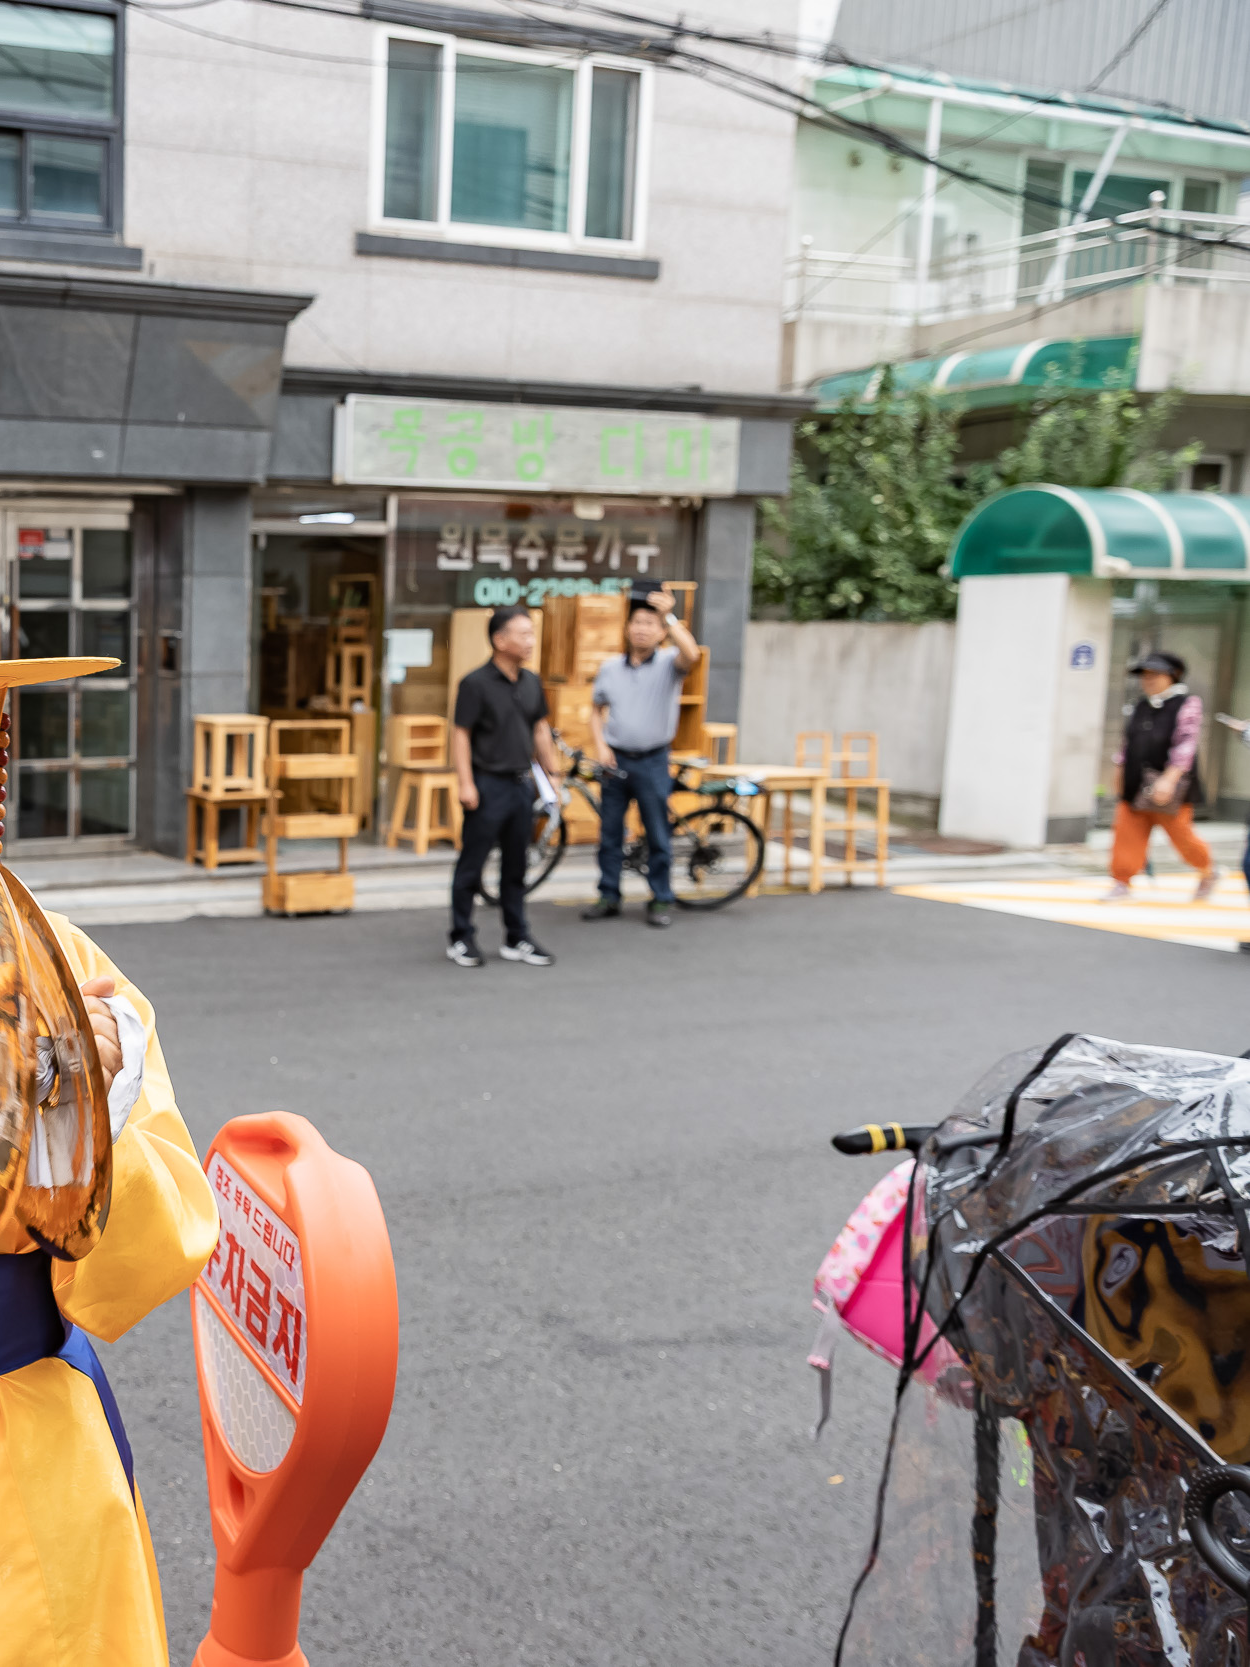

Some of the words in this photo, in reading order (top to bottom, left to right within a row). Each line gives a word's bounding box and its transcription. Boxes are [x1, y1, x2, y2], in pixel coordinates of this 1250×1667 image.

[379, 407, 556, 482] 목공방
[599, 422, 712, 482] 다미
[436, 522, 661, 574] 원목주문가구
[215, 1163, 232, 1202] 협조
